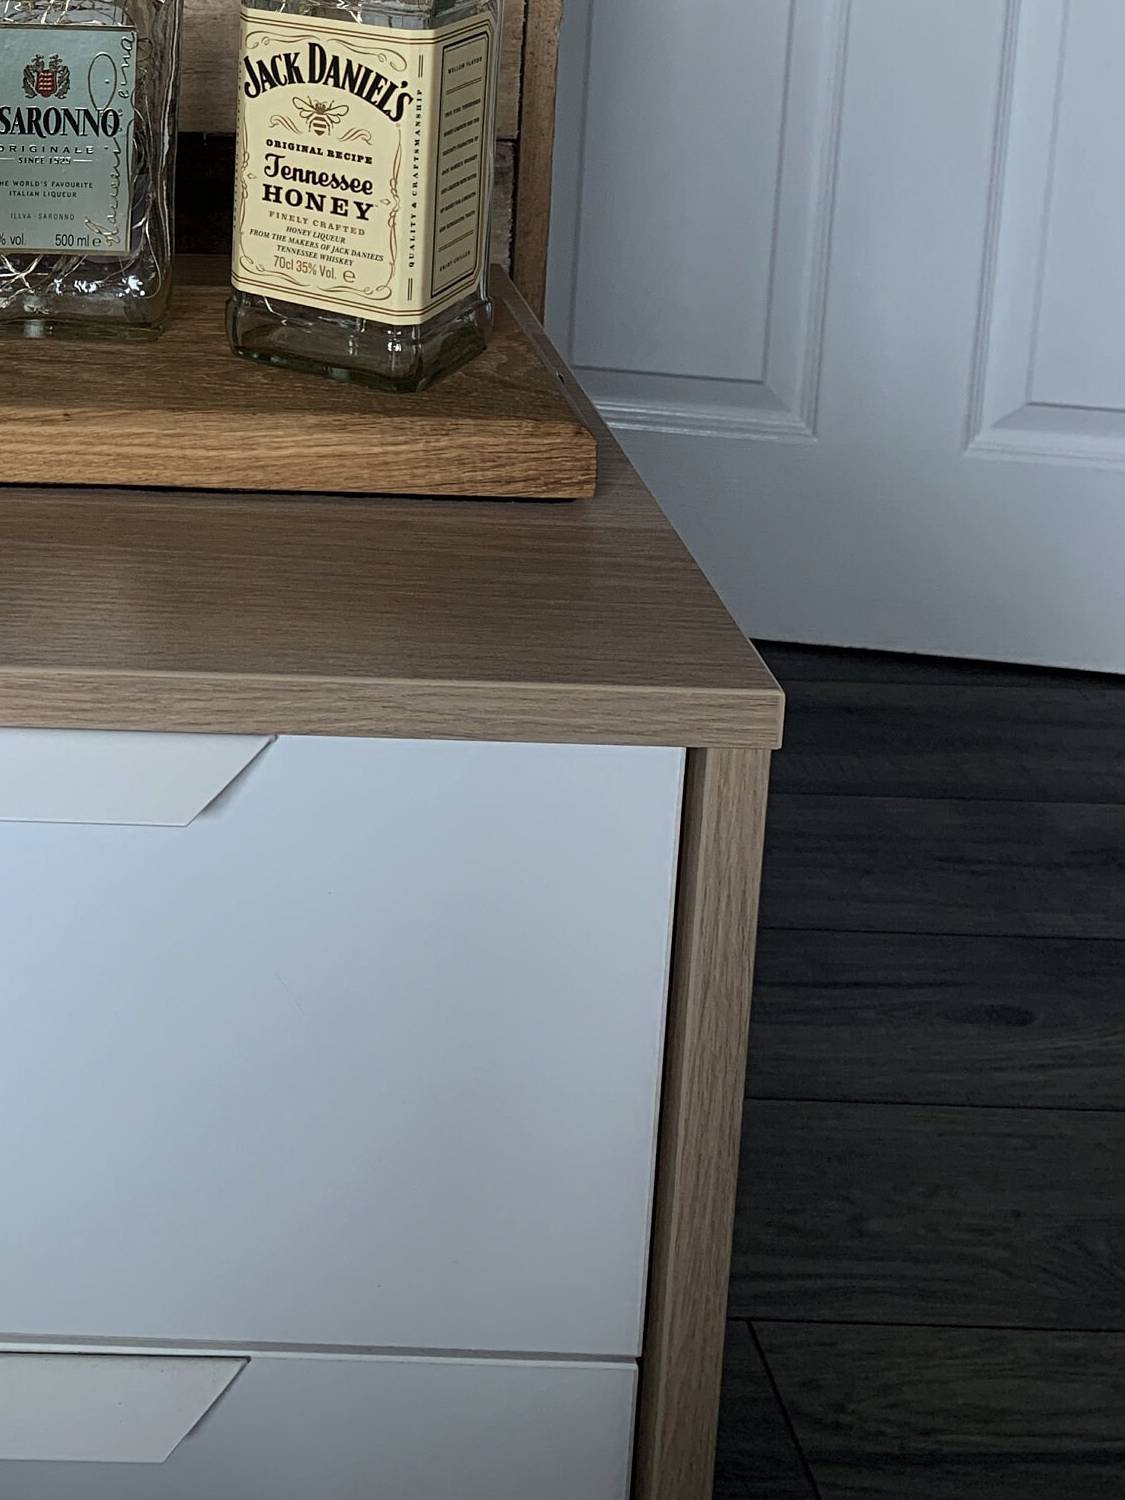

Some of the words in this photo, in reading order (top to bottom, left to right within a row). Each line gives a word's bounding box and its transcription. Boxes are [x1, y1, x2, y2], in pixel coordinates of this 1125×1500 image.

[243, 52, 305, 98] JACK
[307, 42, 413, 122] DANIEL'S
[266, 139, 323, 156] ORIGINAL
[327, 150, 373, 164] RECIPE
[412, 90, 423, 196] CRAFTSMANSHIP
[13, 180, 47, 188] WORLD'S
[263, 152, 373, 196] Tennessee
[9, 190, 39, 198] ITALIAN
[269, 211, 309, 224] FINELY
[313, 220, 365, 236] CRAFTED
[286, 226, 312, 236] HONEY
[313, 232, 346, 244] LIQUEUR
[55, 234, 75, 246] 500
[77, 234, 89, 246] ml
[249, 228, 270, 238] FROM
[271, 234, 287, 242] THE
[288, 237, 319, 250] MAKERS
[331, 245, 349, 255] JACK
[409, 214, 417, 268] QUALITY
[274, 255, 293, 270] 70cl
[295, 260, 317, 276] 35%
[319, 266, 337, 280] Vol.
[277, 245, 318, 259] TENNESSEE
[319, 254, 354, 266] WHISKEY
